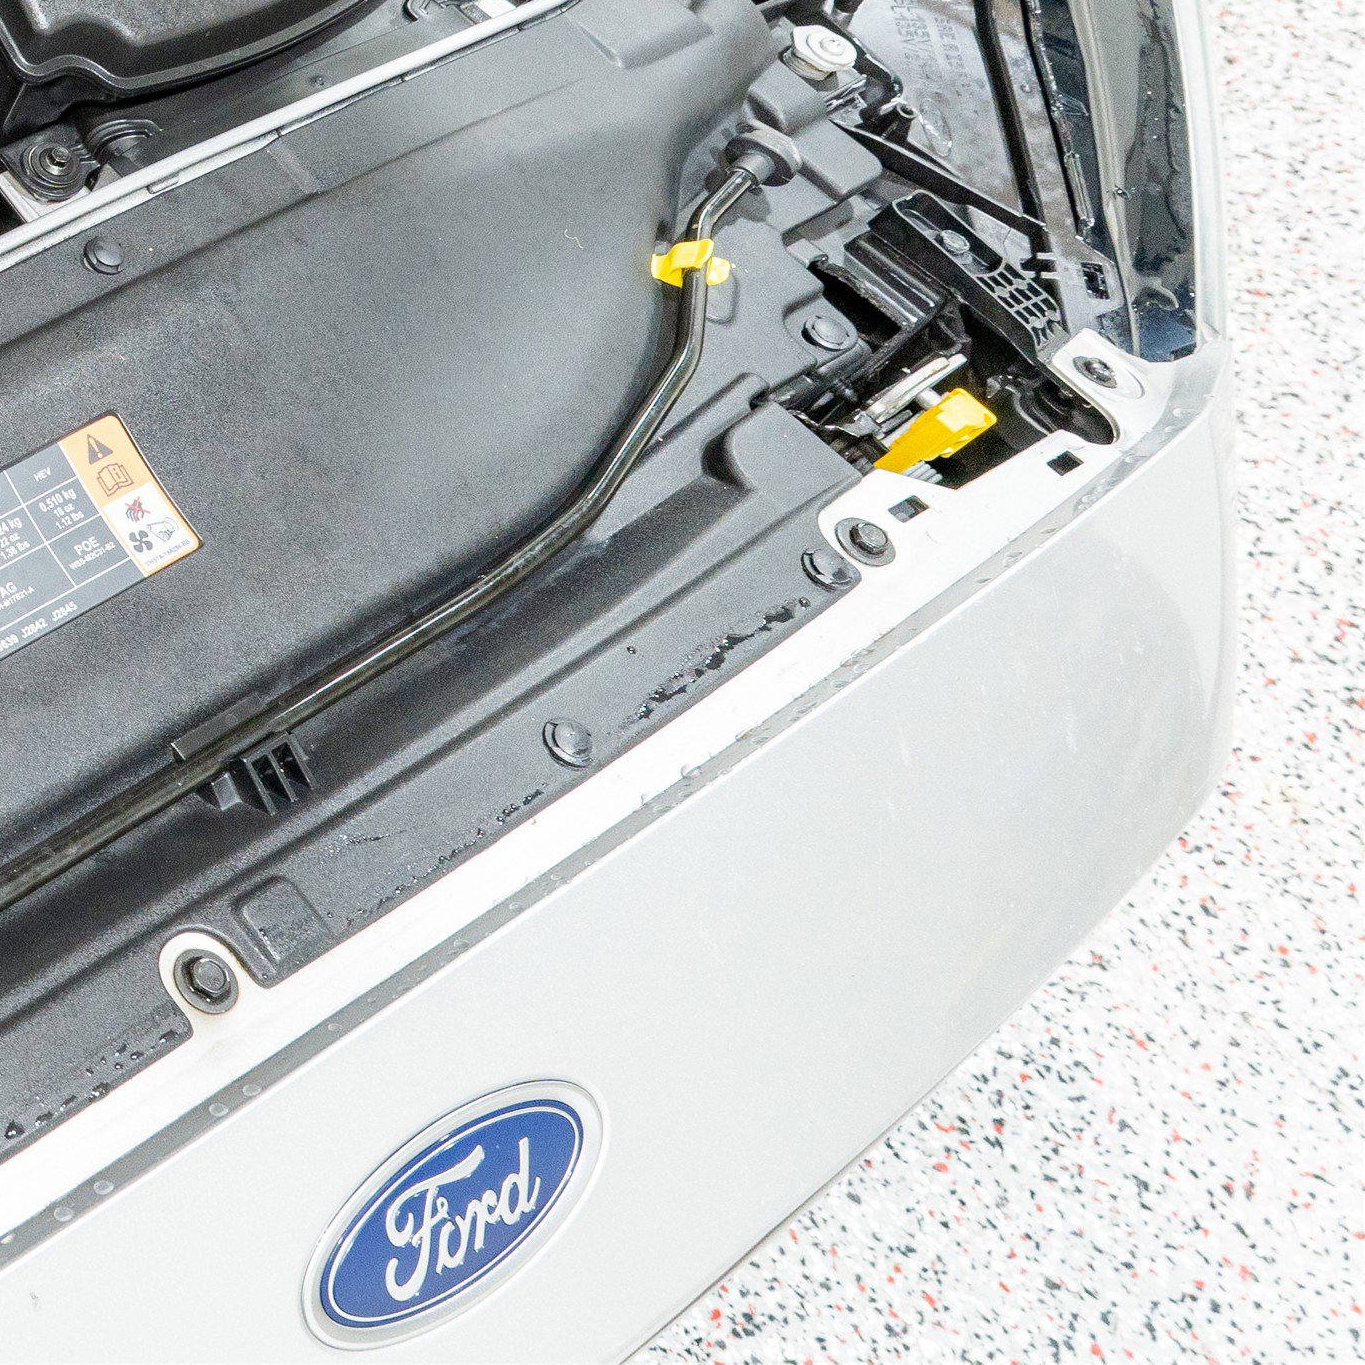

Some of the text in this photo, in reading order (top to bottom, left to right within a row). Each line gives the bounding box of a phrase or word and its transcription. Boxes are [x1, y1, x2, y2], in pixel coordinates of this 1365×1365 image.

[33, 467, 52, 482] HEV
[38, 488, 77, 512] 0.510 kg
[53, 503, 75, 518] 18 oz
[7, 517, 23, 528] kg
[55, 511, 84, 530] 1.12 lbs
[9, 532, 21, 543] oz
[73, 536, 100, 555] POE
[0, 540, 30, 560] 1.38 lbs
[20, 617, 48, 639] J2842
[51, 601, 78, 622] J2845
[384, 1136, 542, 1302] Ford
